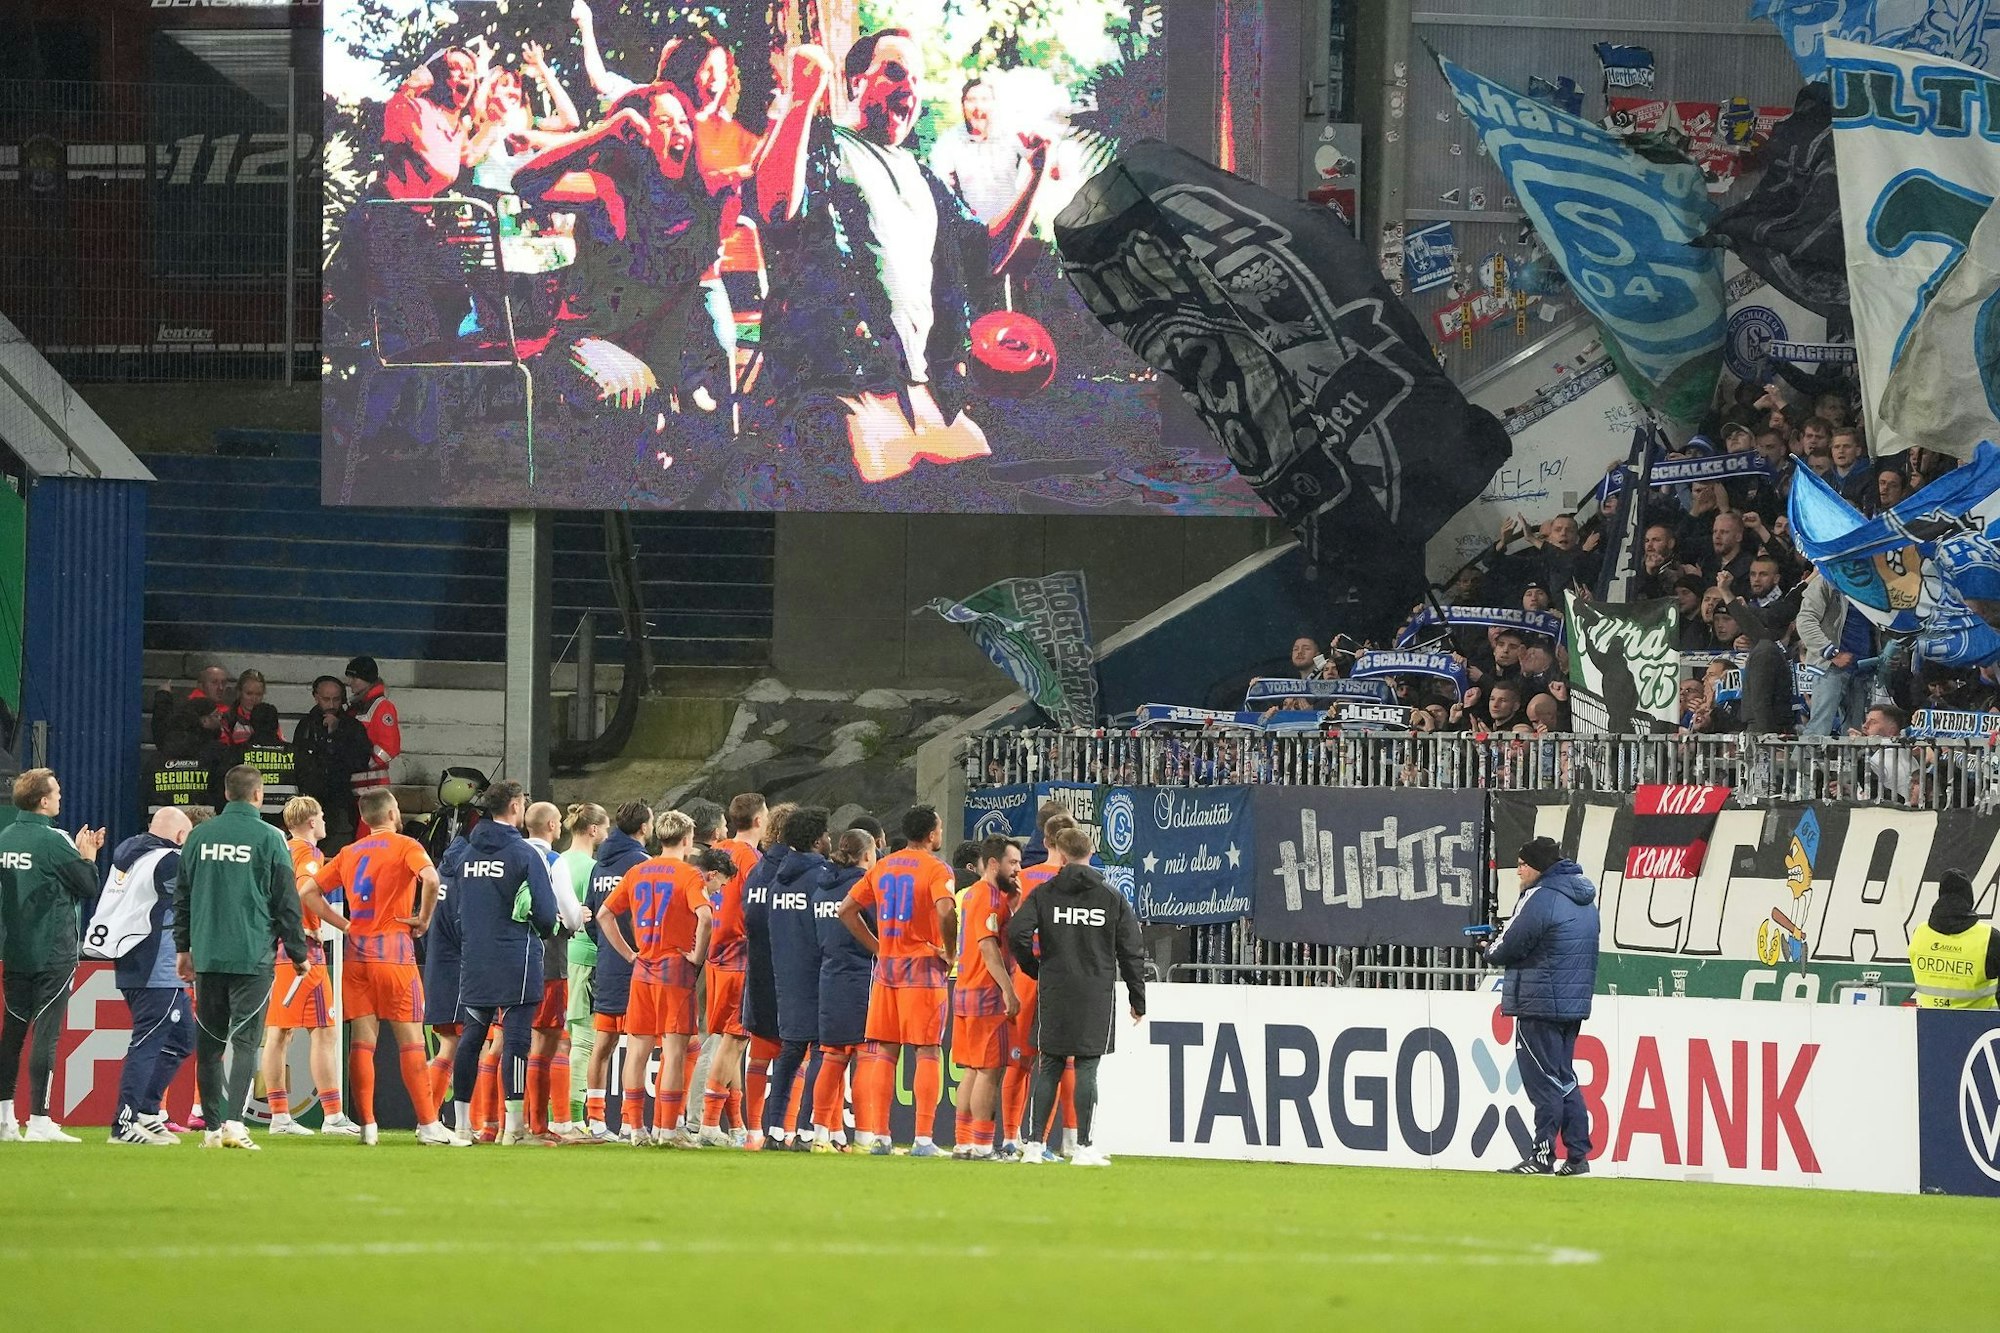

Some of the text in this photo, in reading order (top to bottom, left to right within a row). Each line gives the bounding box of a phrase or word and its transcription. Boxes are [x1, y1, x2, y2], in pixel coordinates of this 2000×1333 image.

[1739, 311, 1772, 325] SCHALKE
[1651, 456, 1748, 480] SCHALKE 04
[1452, 606, 1522, 624] SCHALKE
[1525, 611, 1544, 627] 04
[1373, 652, 1429, 668] SCHALKE
[1429, 654, 1447, 670] 04
[1340, 704, 1404, 724] HUGOS
[1932, 712, 1976, 732] WERDEN
[244, 752, 295, 763] SECURITY
[155, 771, 209, 784] SECURITY
[1153, 788, 1233, 829] Solidarität
[200, 843, 252, 863] HRS
[1164, 843, 1222, 875] mit allen
[1273, 808, 1475, 911] HUGOS
[353, 856, 374, 899] 4
[463, 860, 505, 878] HRS
[635, 881, 673, 927] 27
[772, 892, 808, 910] HRS
[879, 873, 915, 922] 30
[1053, 906, 1106, 927] HRS
[89, 924, 109, 947] 8
[1917, 956, 1974, 976] ORDNER
[1933, 998, 1951, 1008] 554
[1150, 1021, 1460, 1158] TARGO
[1556, 1035, 1823, 1174] BANK
